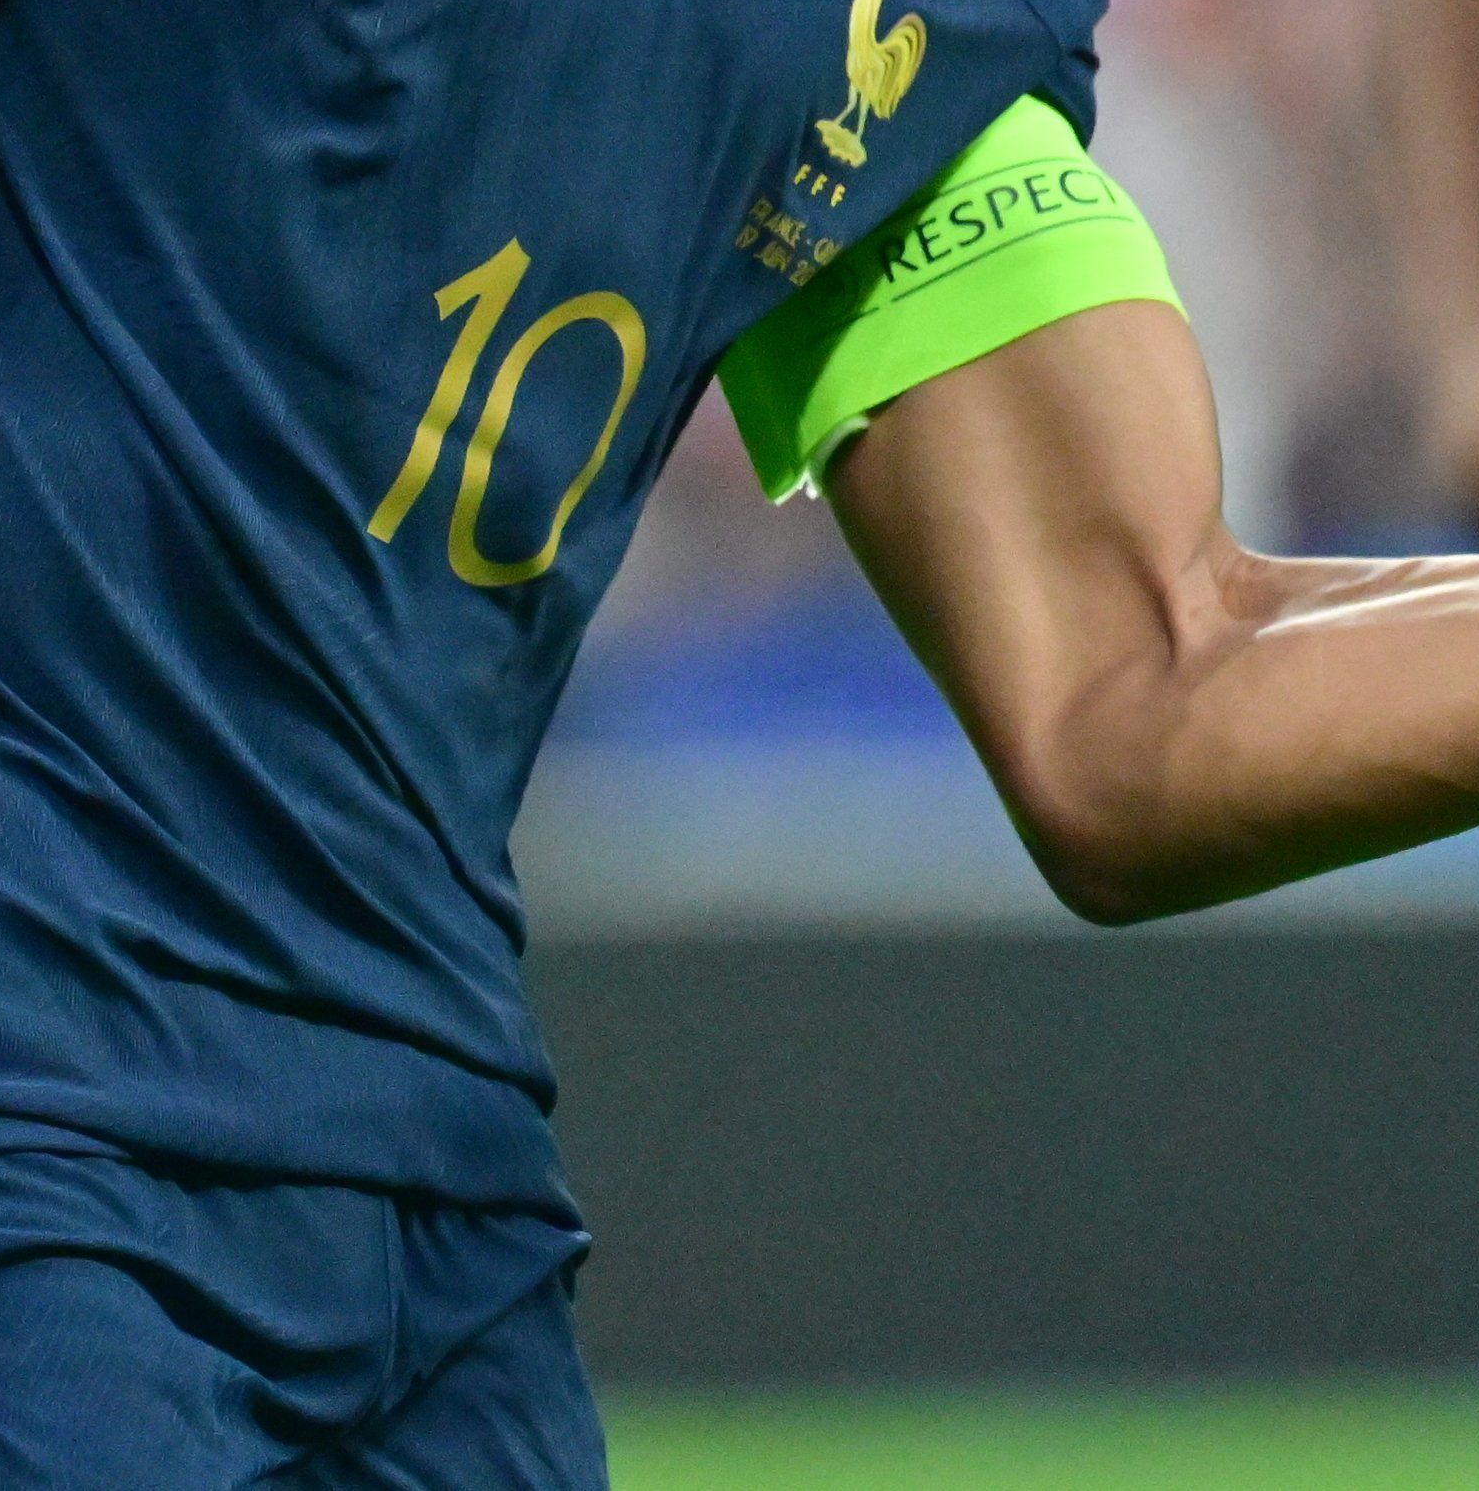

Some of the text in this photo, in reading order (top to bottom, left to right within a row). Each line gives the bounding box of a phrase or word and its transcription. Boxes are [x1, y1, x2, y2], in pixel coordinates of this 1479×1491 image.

[793, 164, 846, 207] FFF
[880, 168, 1117, 284] RESPECT
[367, 237, 646, 587] 10
